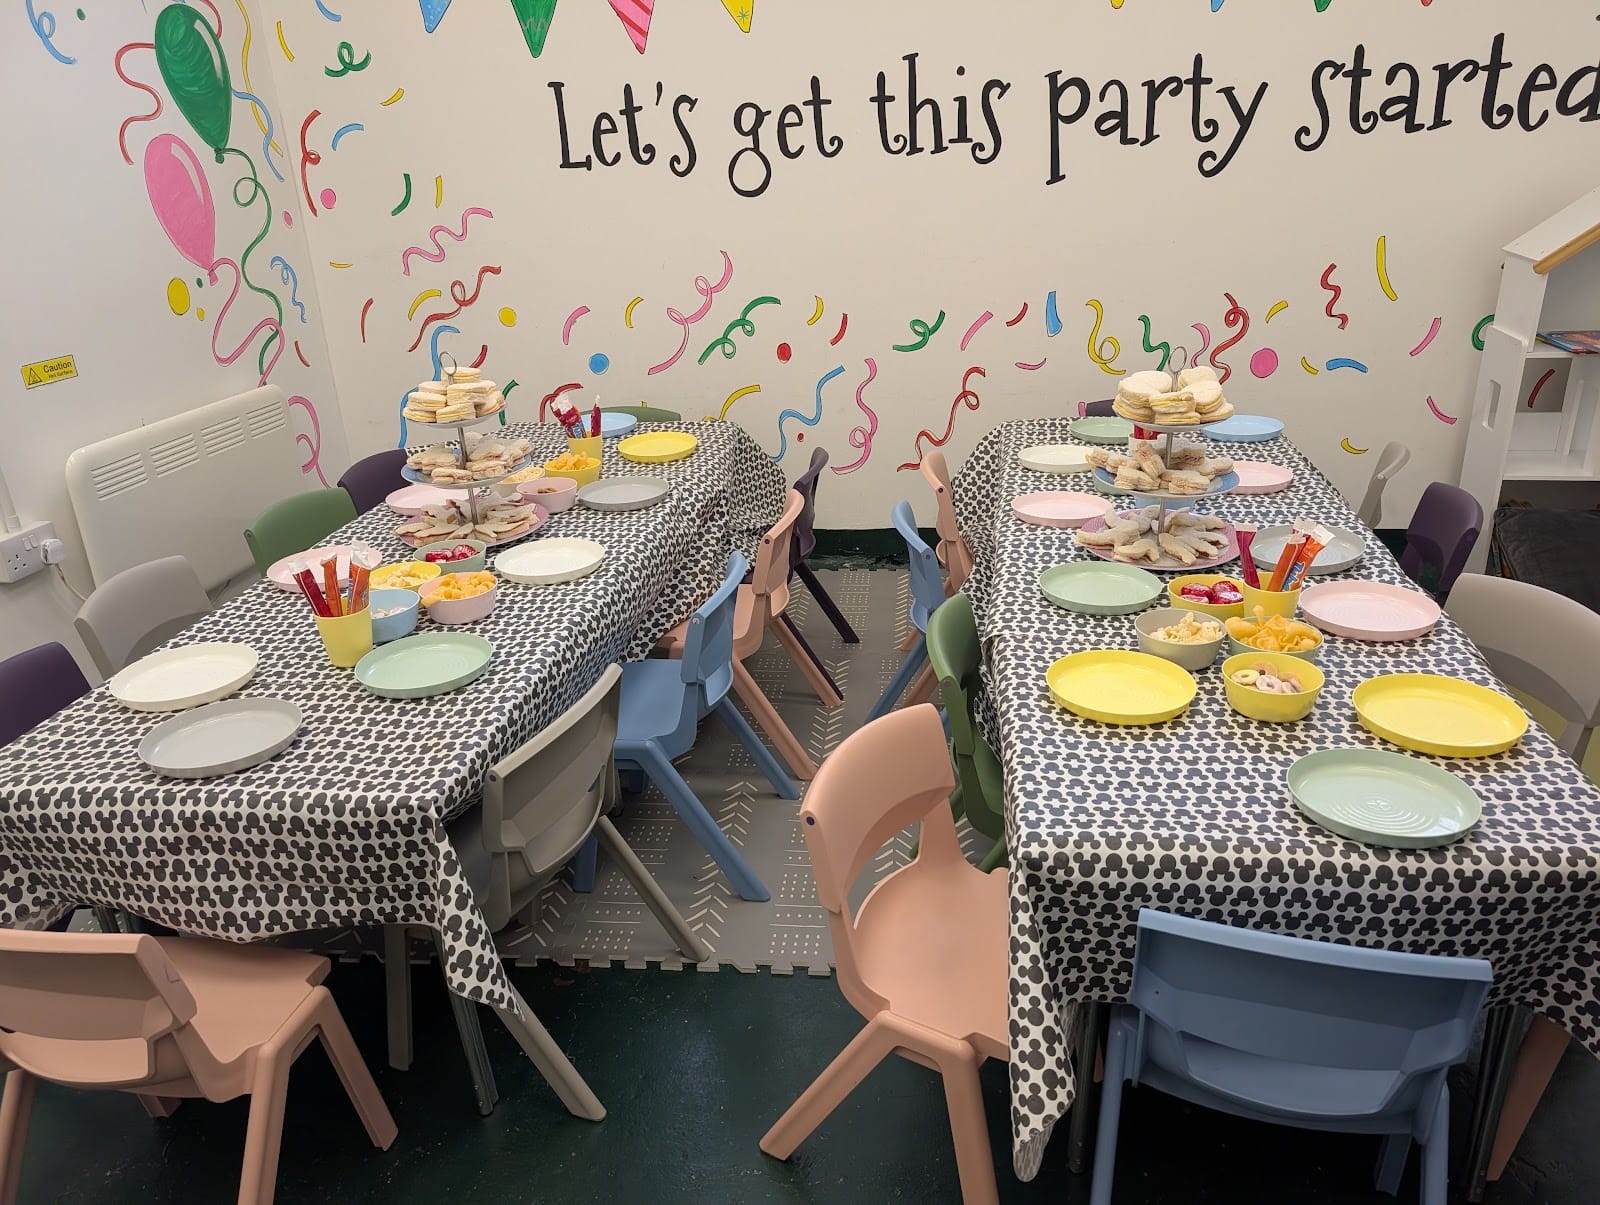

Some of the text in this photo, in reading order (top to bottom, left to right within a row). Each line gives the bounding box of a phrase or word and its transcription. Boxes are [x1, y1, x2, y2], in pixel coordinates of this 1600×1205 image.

[547, 81, 699, 178] Let's
[728, 75, 844, 198] get
[869, 52, 1011, 165] this
[1044, 53, 1269, 186] party
[43, 361, 73, 373] Caution
